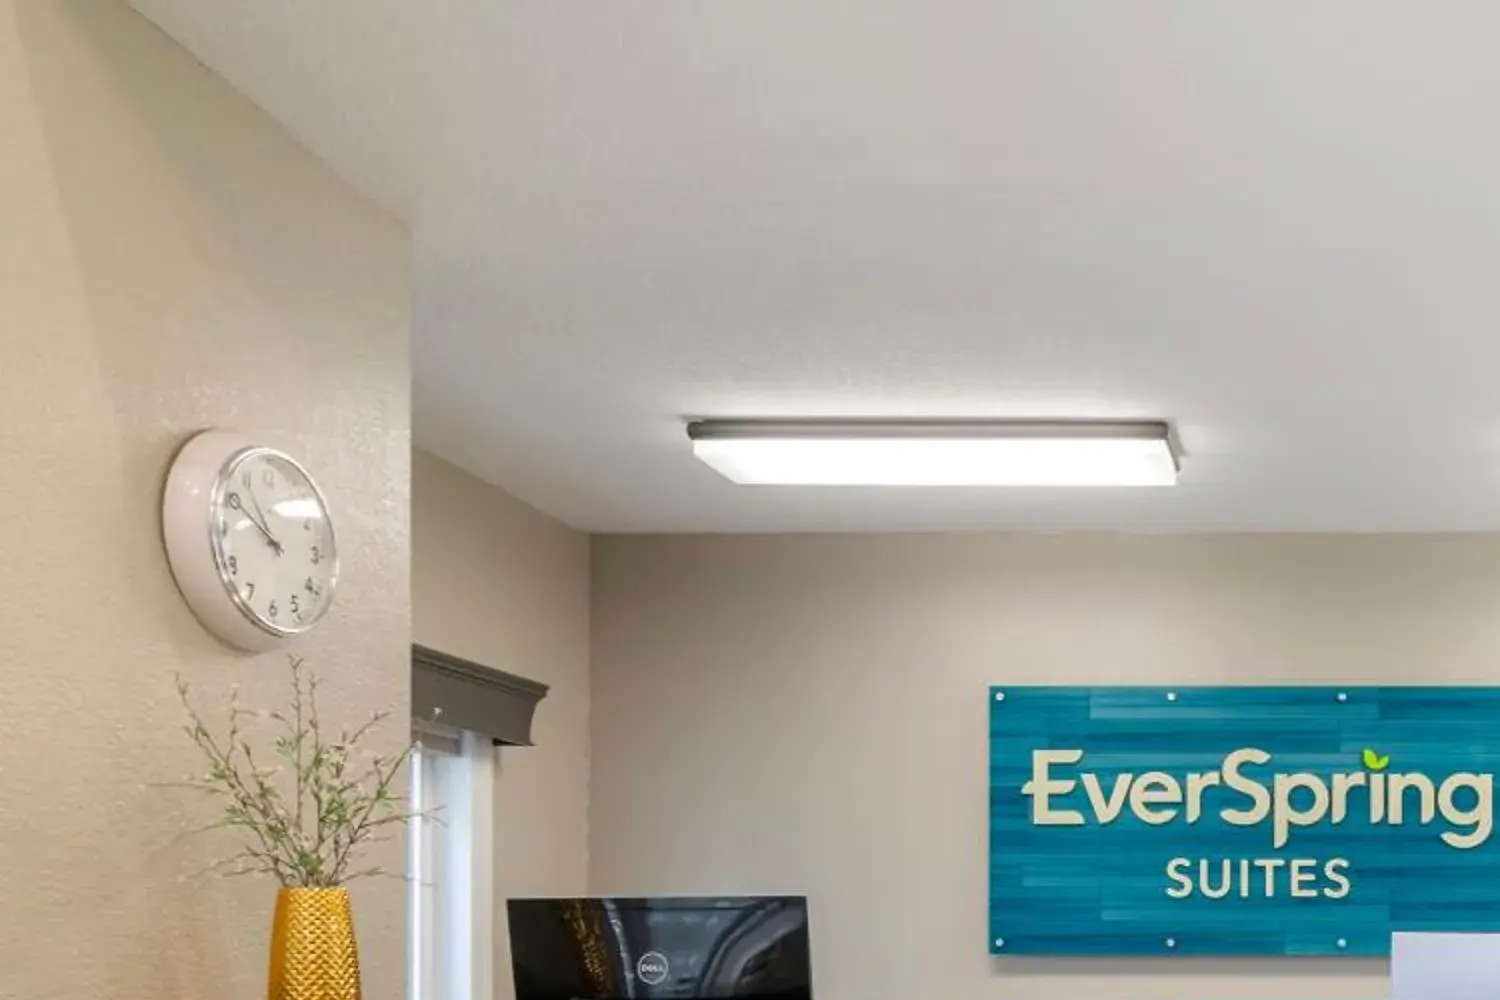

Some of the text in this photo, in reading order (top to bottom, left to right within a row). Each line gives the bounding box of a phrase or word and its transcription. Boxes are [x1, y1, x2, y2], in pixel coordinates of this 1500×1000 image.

[311, 546, 319, 564] 3
[245, 582, 255, 601] 7
[268, 600, 278, 618] 6
[1021, 747, 1494, 849] EverSpring
[1165, 857, 1352, 900] SUITES
